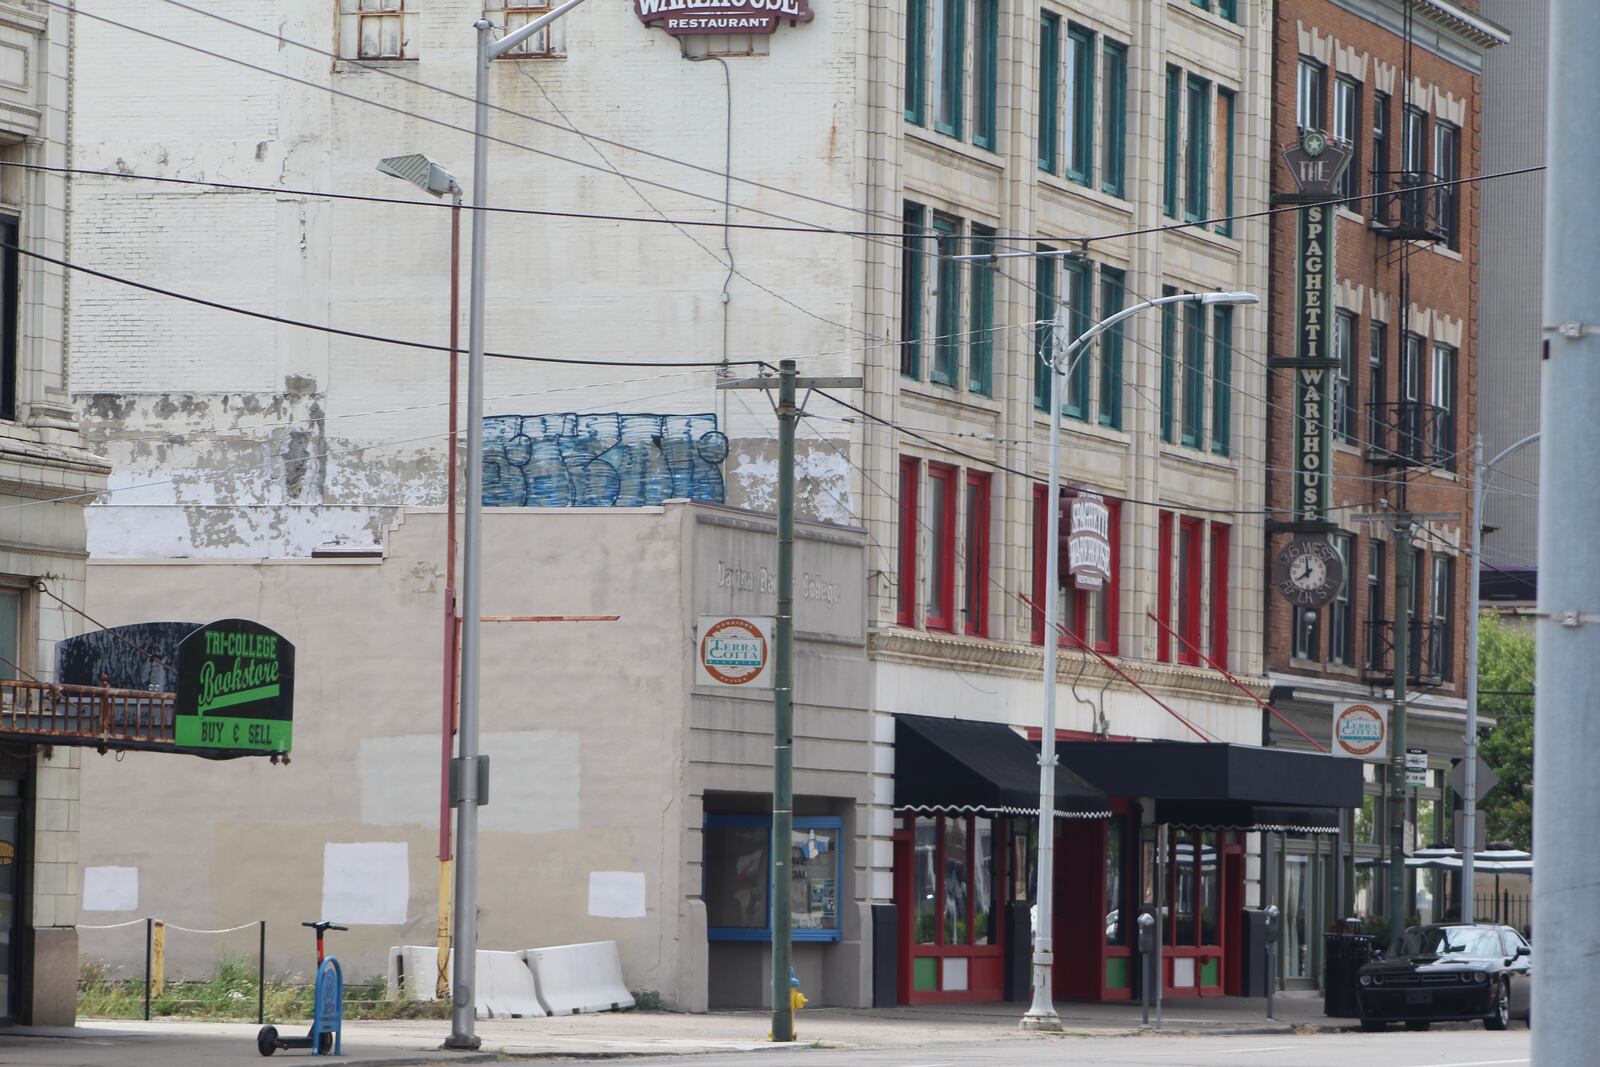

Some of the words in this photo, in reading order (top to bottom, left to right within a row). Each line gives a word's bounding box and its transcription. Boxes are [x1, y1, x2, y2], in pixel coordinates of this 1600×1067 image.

[668, 18, 769, 28] RESTAURANT
[1299, 160, 1330, 182] THE
[1305, 206, 1323, 357] SPAGHETTI
[1301, 368, 1324, 521] WAREHOUSE
[1302, 541, 1336, 563] WEST
[205, 631, 278, 658] TRI-COLLEGE
[709, 648, 759, 660] COTTA
[710, 640, 758, 652] TERRA
[199, 655, 279, 706] Bookstore
[202, 721, 223, 743] BUY
[248, 724, 272, 745] SELL
[1343, 719, 1378, 730] TERRA
